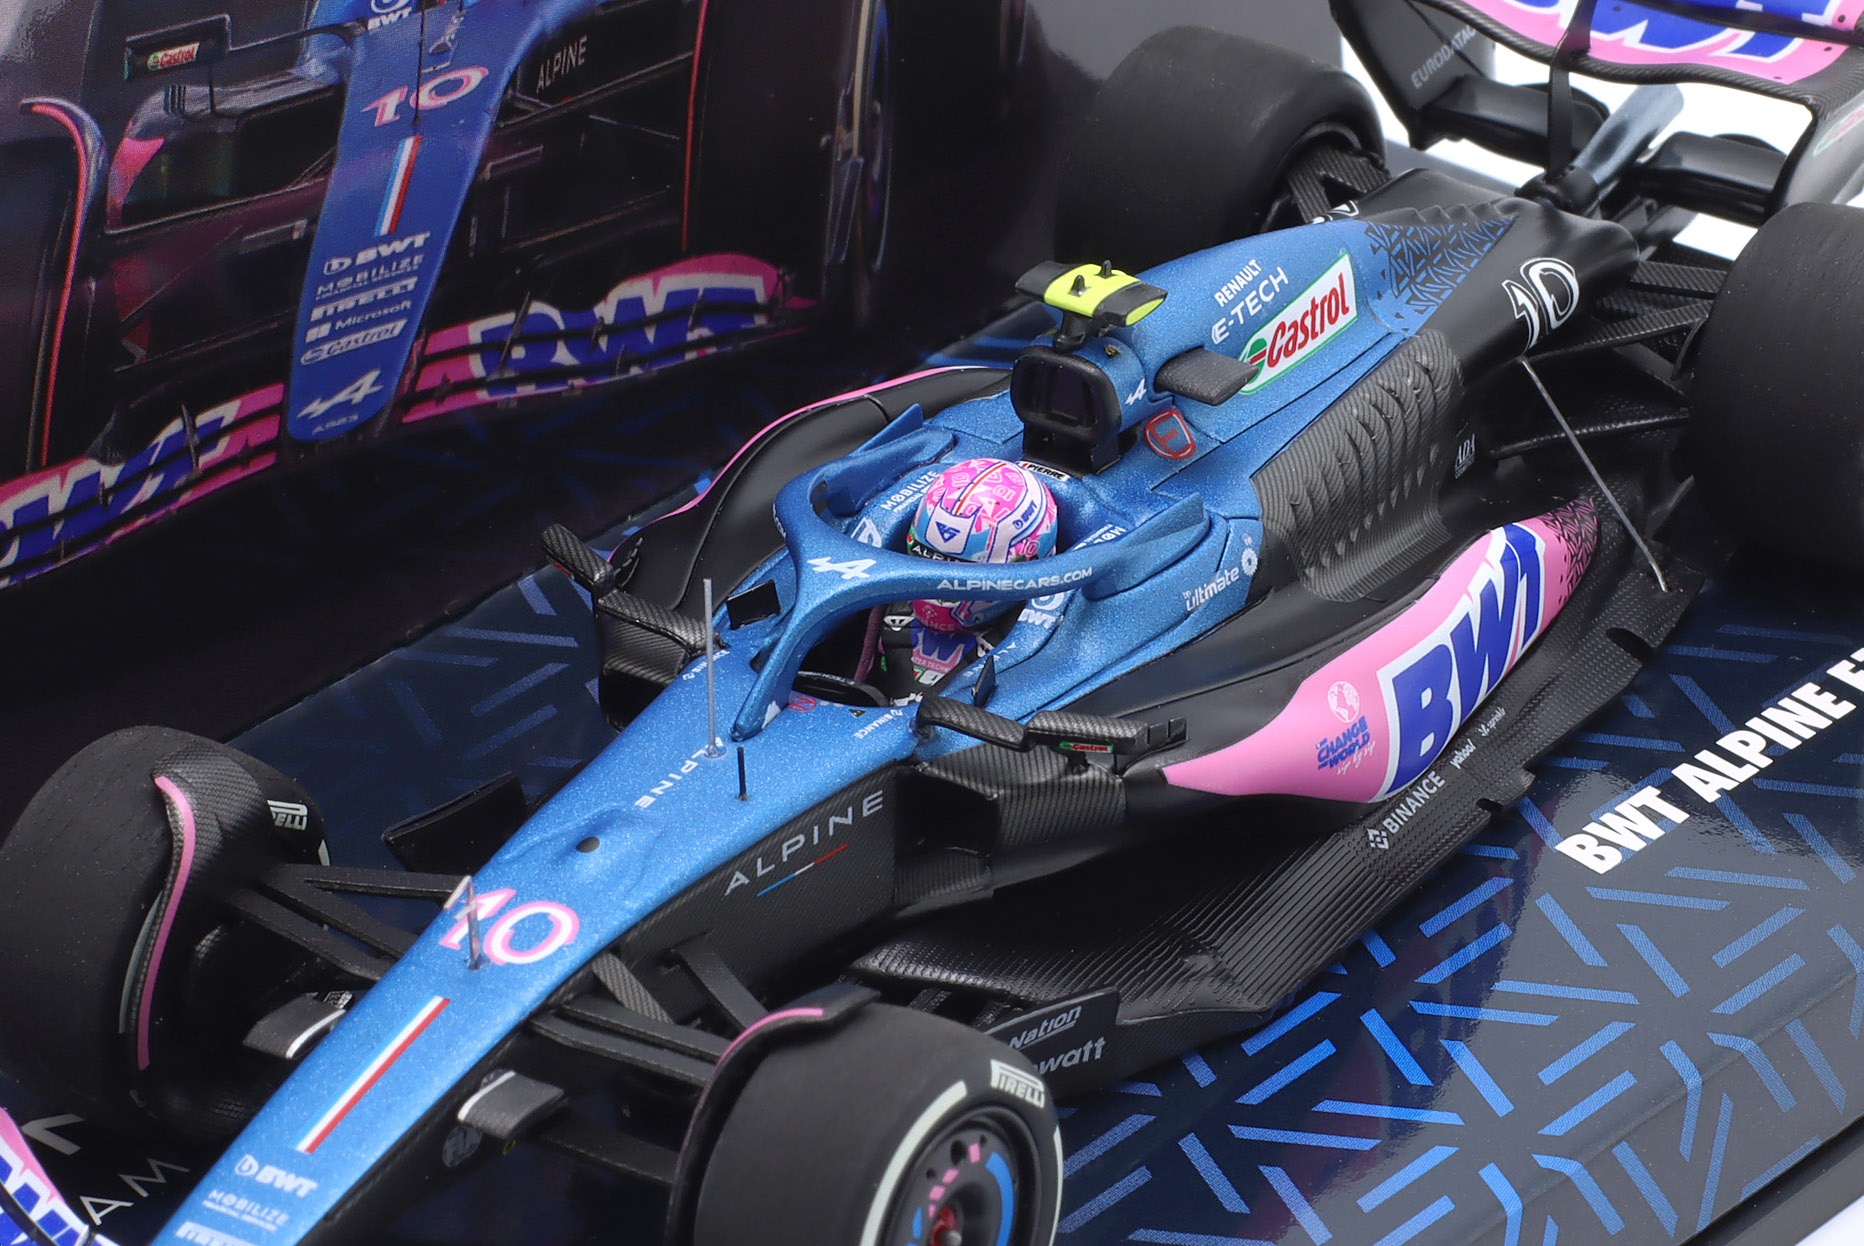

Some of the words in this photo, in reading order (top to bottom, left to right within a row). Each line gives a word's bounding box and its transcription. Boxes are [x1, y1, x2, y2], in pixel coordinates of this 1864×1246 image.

[368, 6, 412, 30] BWT
[536, 35, 588, 94] ALPINE
[361, 66, 490, 126] 10
[355, 231, 430, 265] BWT
[1211, 266, 1289, 345] E-TECH
[1214, 259, 1262, 307] RENAULT
[335, 300, 412, 330] Microsoft
[1267, 271, 1350, 368] Castrol
[1027, 463, 1066, 480] PIERRE
[937, 566, 1093, 592] ALPINECARS.COM
[1378, 523, 1545, 801] BWT
[854, 708, 894, 739] BINANCE
[1317, 715, 1368, 763] CHANGE
[1384, 769, 1447, 835] BINANCE
[1554, 784, 1691, 875] BWT
[1671, 681, 1858, 804] ALPINE
[725, 790, 884, 897] ALPINE
[440, 887, 581, 967] 10
[1009, 1005, 1082, 1050] Nation
[1035, 1036, 1106, 1076] watt
[990, 1058, 1046, 1109] PIRELLI
[255, 1165, 319, 1199] BWT
